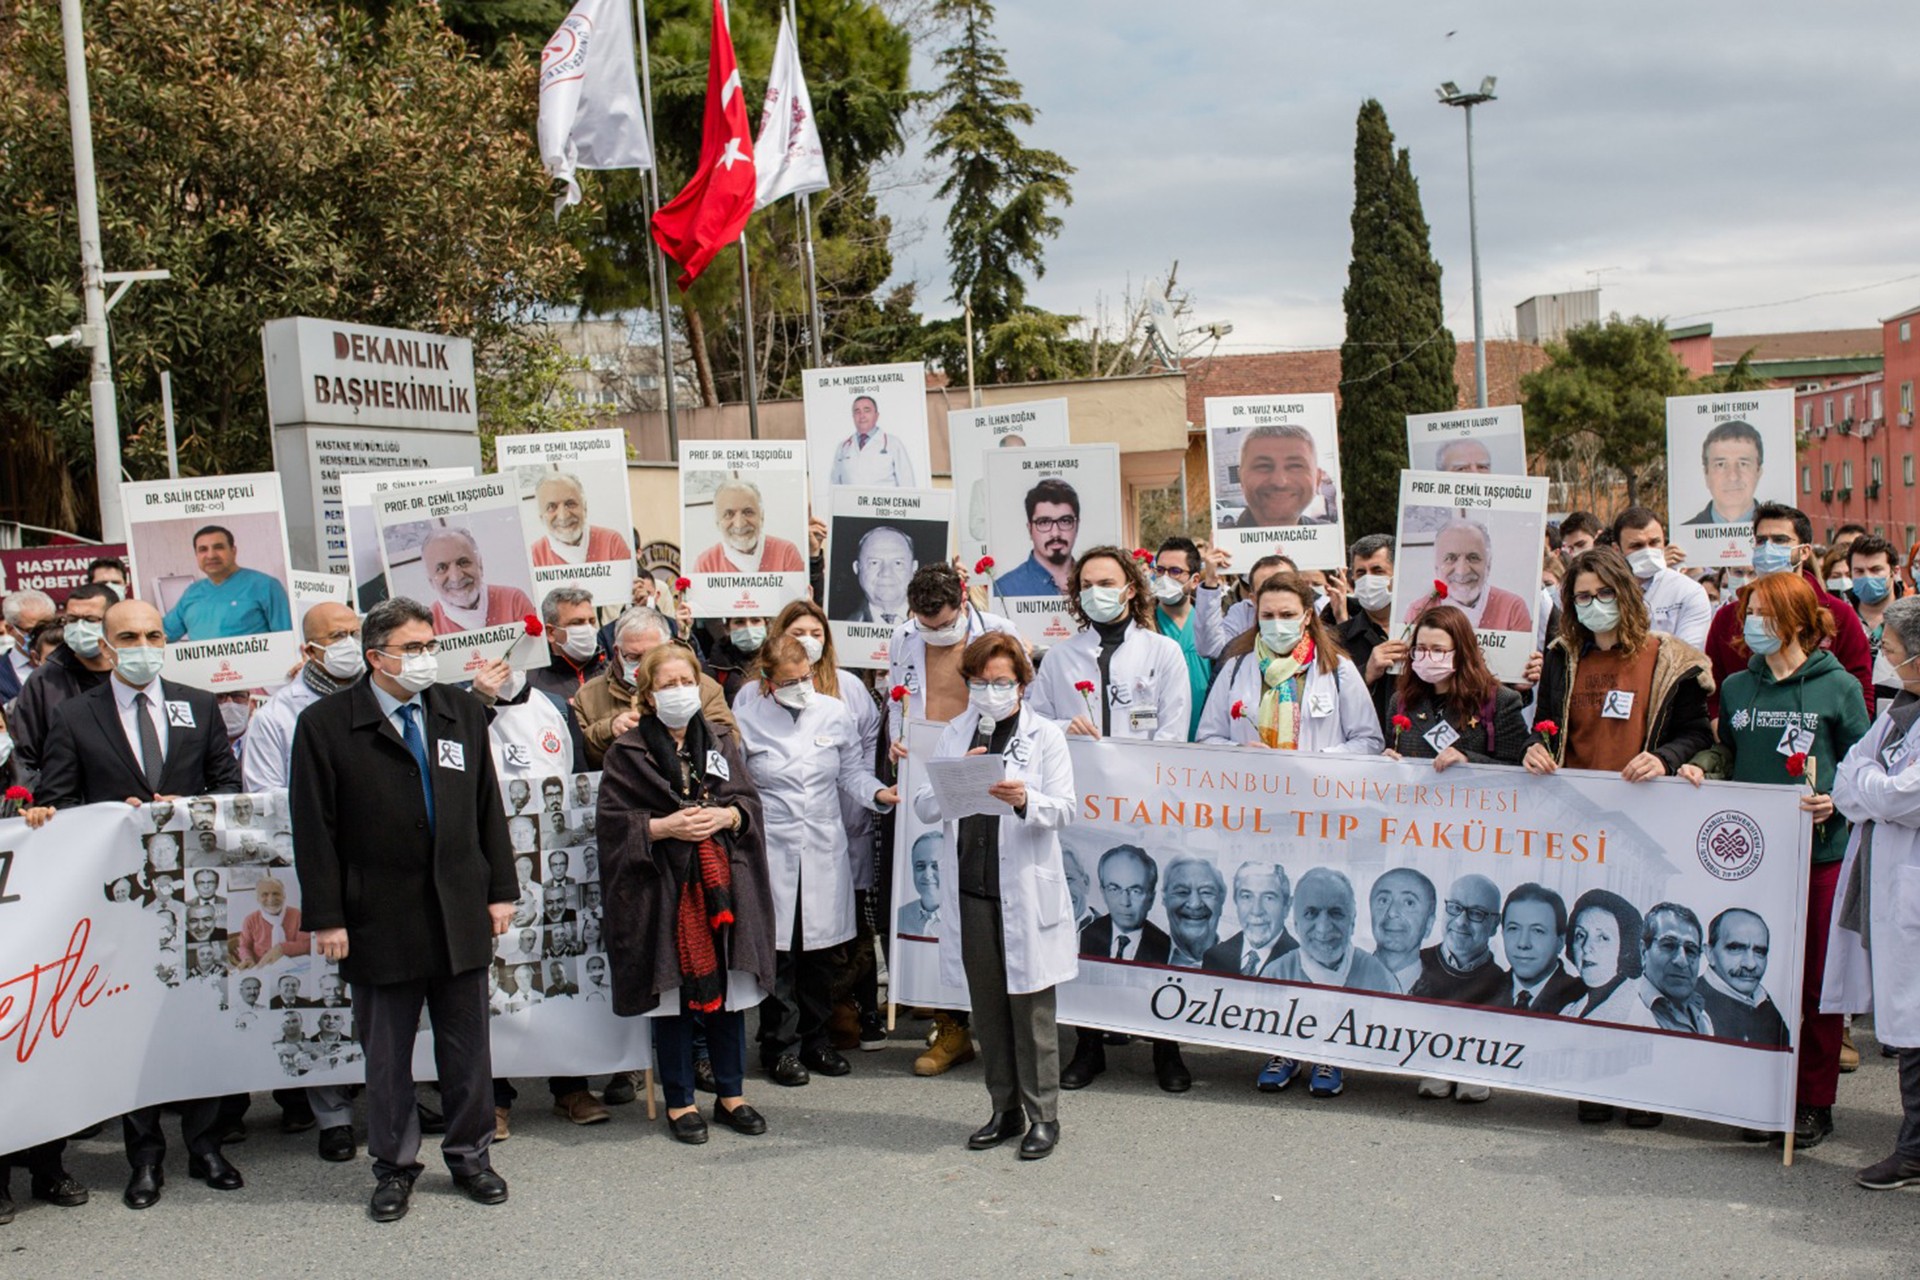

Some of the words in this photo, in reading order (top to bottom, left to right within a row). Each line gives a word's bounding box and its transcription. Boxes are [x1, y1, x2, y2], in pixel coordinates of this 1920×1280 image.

[333, 331, 449, 371] DEKANLIK
[819, 378, 831, 387] DR.
[833, 378, 842, 387] M.
[843, 375, 876, 386] MUSTAFA
[877, 373, 905, 383] KARTAL
[314, 374, 471, 415] BAŞHEKİMLİK
[1233, 406, 1246, 416] DR.
[1248, 405, 1271, 415] YAVUZ
[1272, 404, 1304, 414] KALAYCI
[1697, 404, 1710, 414] DR.
[1711, 402, 1731, 414] ÜMİT
[1732, 401, 1759, 412] ERDEM
[975, 418, 987, 428] DR.
[988, 414, 1010, 426] İLHAN
[1011, 411, 1036, 424] DOĞAN
[1427, 422, 1440, 432] DR.
[1441, 420, 1470, 431] MEHMET
[1471, 416, 1499, 428] ULUSOY
[316, 440, 352, 452] HASTANE
[506, 445, 528, 456] PROF.
[530, 444, 543, 454] DR.
[544, 440, 568, 453] CEMİL
[569, 438, 611, 452] TAŞÇIOĞLU
[689, 450, 711, 460] PROF.
[712, 450, 725, 460] DR.
[726, 449, 750, 460] CEMİL
[751, 448, 793, 462] TAŞÇIOĞLU
[1022, 460, 1034, 470] DR.
[1034, 460, 1056, 470] AHMET
[1057, 459, 1079, 470] AKBAŞ
[145, 493, 162, 505] DR.
[164, 488, 193, 504] SALİH
[194, 489, 226, 502] CENAP
[227, 484, 255, 501] ÇEVLİ
[385, 500, 410, 513] PROF.
[411, 497, 426, 510] DR.
[428, 491, 456, 507] CEMİL
[456, 485, 504, 503] TAŞÇIOĞLU
[1411, 481, 1436, 494] PROF.
[1437, 483, 1452, 495] DR.
[1454, 482, 1482, 497] CEMİL
[1484, 484, 1532, 500] TAŞÇIOĞLU
[857, 496, 870, 506] DR.
[872, 496, 892, 507] ASIM
[892, 495, 921, 508] CENANİ
[1240, 527, 1318, 544] UNUTMAYACAĞIZ
[535, 563, 612, 582] UNUTMAYACAĞIZ
[707, 573, 784, 588] UNUTMAYACAĞIZ
[175, 636, 270, 662] UNUTMAYACAĞIZ
[438, 627, 517, 653] NUTMAYACAĞIZ
[1156, 762, 1297, 796] İSTANBUL
[1312, 775, 1518, 813] ÜNİVERSİTESİ
[1084, 794, 1272, 834] STANBUL
[1291, 810, 1359, 841] TIP
[1379, 818, 1607, 864] FAKÜLTESİ
[1150, 976, 1318, 1040] Özlemle
[1323, 1008, 1526, 1068] Anıyoruz
